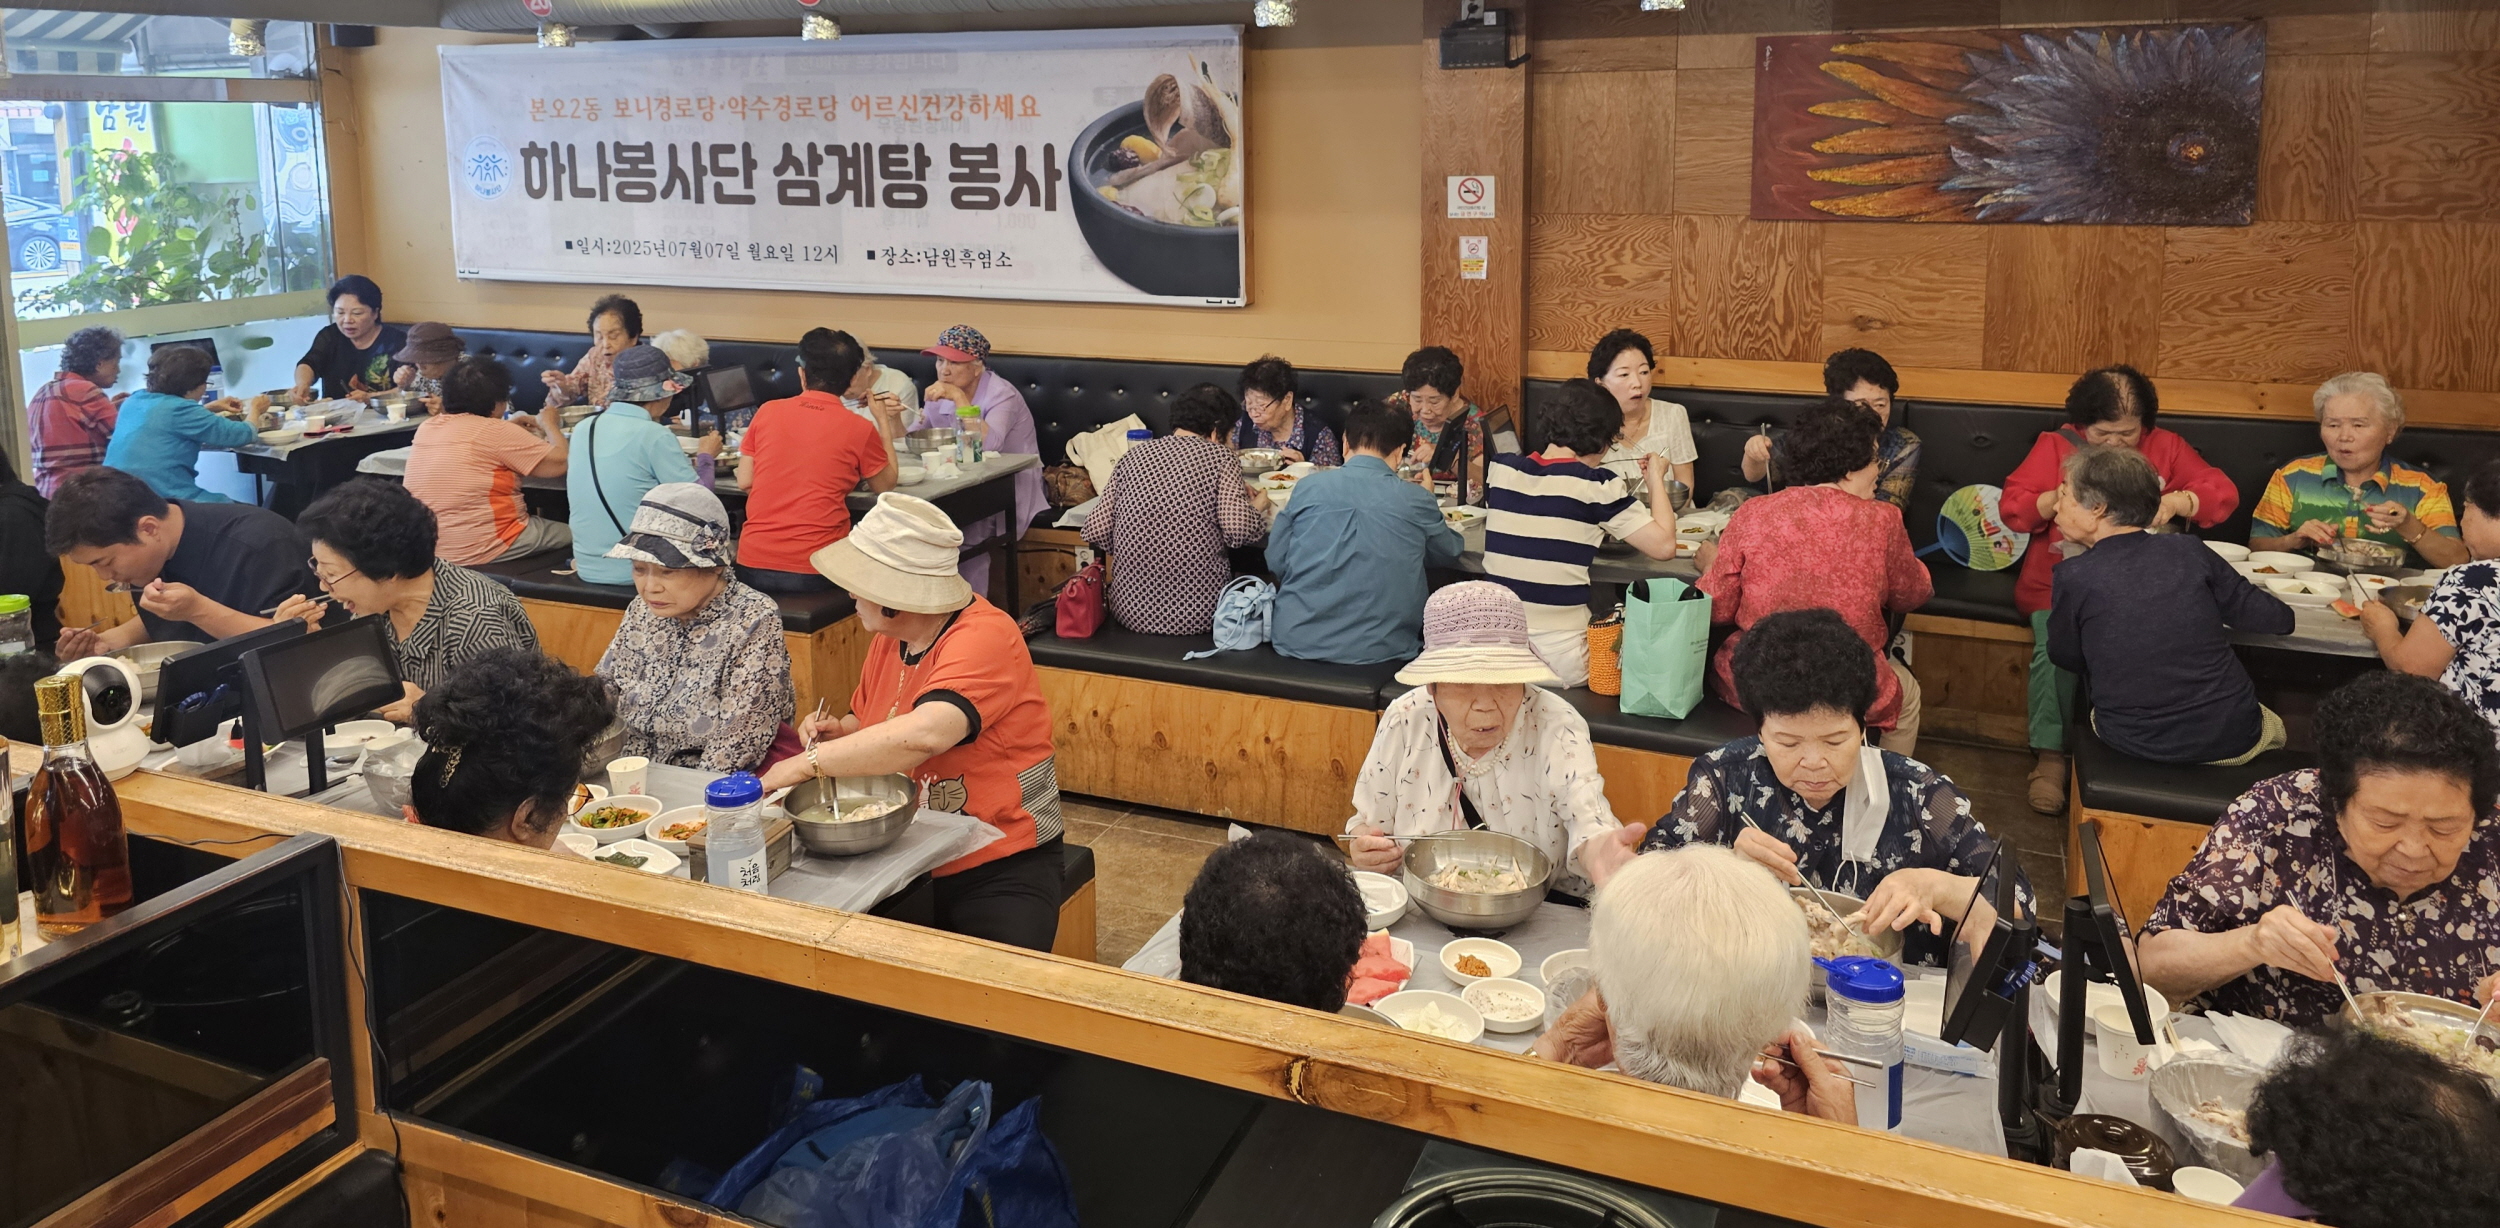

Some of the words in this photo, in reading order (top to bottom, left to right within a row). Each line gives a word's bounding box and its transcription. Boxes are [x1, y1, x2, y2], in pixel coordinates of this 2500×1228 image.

[529, 97, 602, 122] 본오2동
[614, 94, 839, 122] 보니경로당·약수경로당
[852, 93, 1041, 122] 어르신건강하세요
[520, 140, 758, 205] 하나봉사단
[773, 142, 932, 208] 삼계탕
[948, 142, 1062, 211] 봉사
[576, 237, 741, 261] 일시:2025년07월07일
[747, 242, 795, 263] 월요일
[804, 245, 839, 264] 12시
[881, 247, 1013, 269] 장소:남원흑염소
[740, 863, 760, 877] 처음
[740, 873, 761, 888] 처럼
